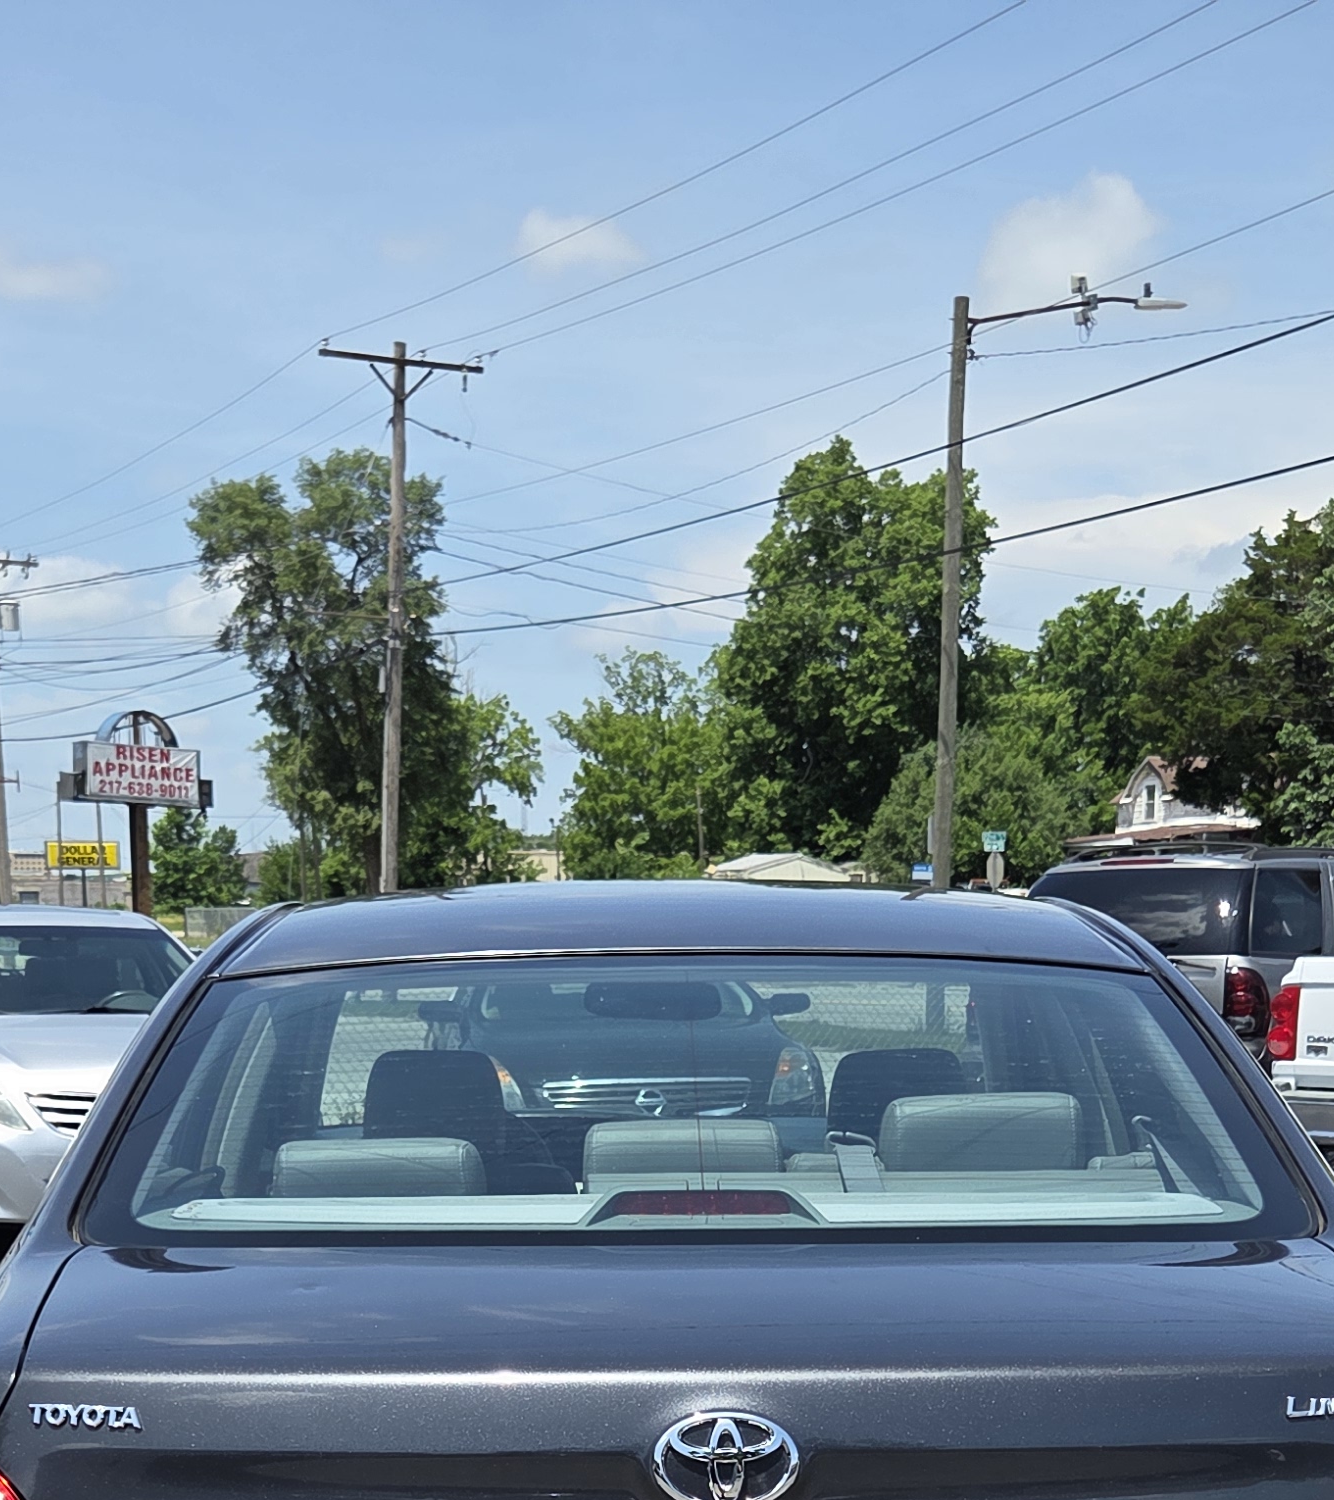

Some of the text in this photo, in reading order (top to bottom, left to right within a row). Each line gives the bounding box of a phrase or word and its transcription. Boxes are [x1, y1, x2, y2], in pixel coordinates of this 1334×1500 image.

[116, 745, 171, 763] RISEN
[92, 761, 196, 783] APPLIANCE
[28, 1403, 142, 1429] TOYOTA
